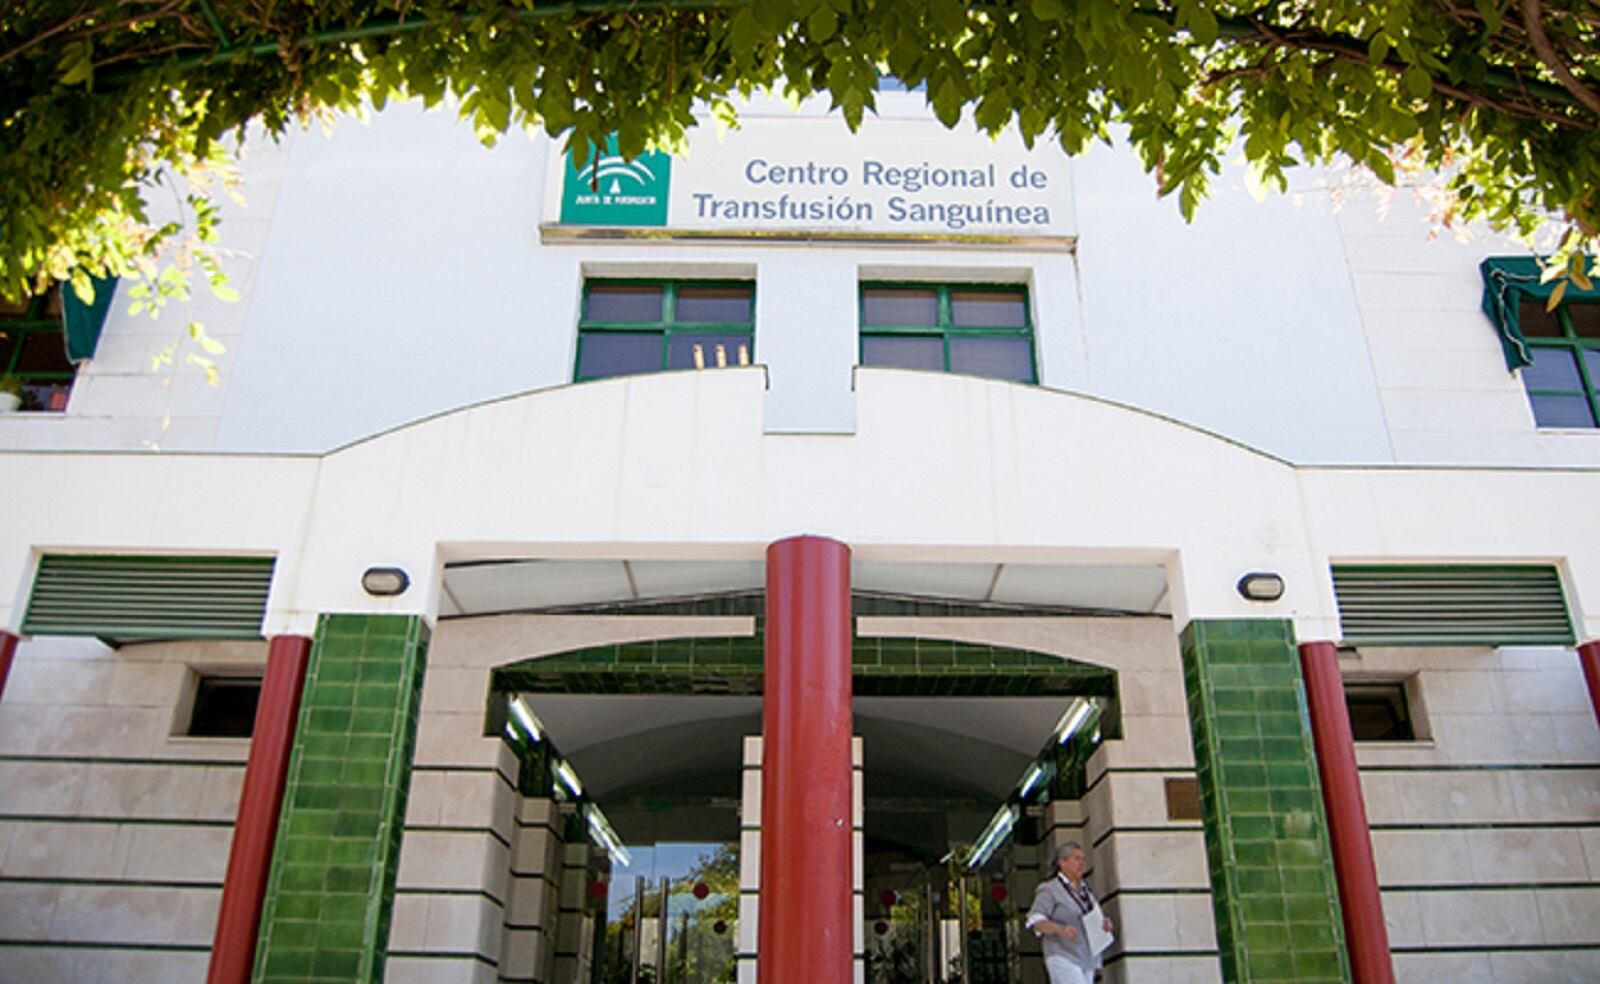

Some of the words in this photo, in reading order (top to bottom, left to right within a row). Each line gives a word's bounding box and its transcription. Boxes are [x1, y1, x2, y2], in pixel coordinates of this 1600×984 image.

[746, 159, 849, 185] Centro
[863, 161, 996, 192] Regional
[1011, 164, 1048, 188] de
[692, 193, 873, 221] Transfusión
[887, 196, 1051, 229] Sanguínea
